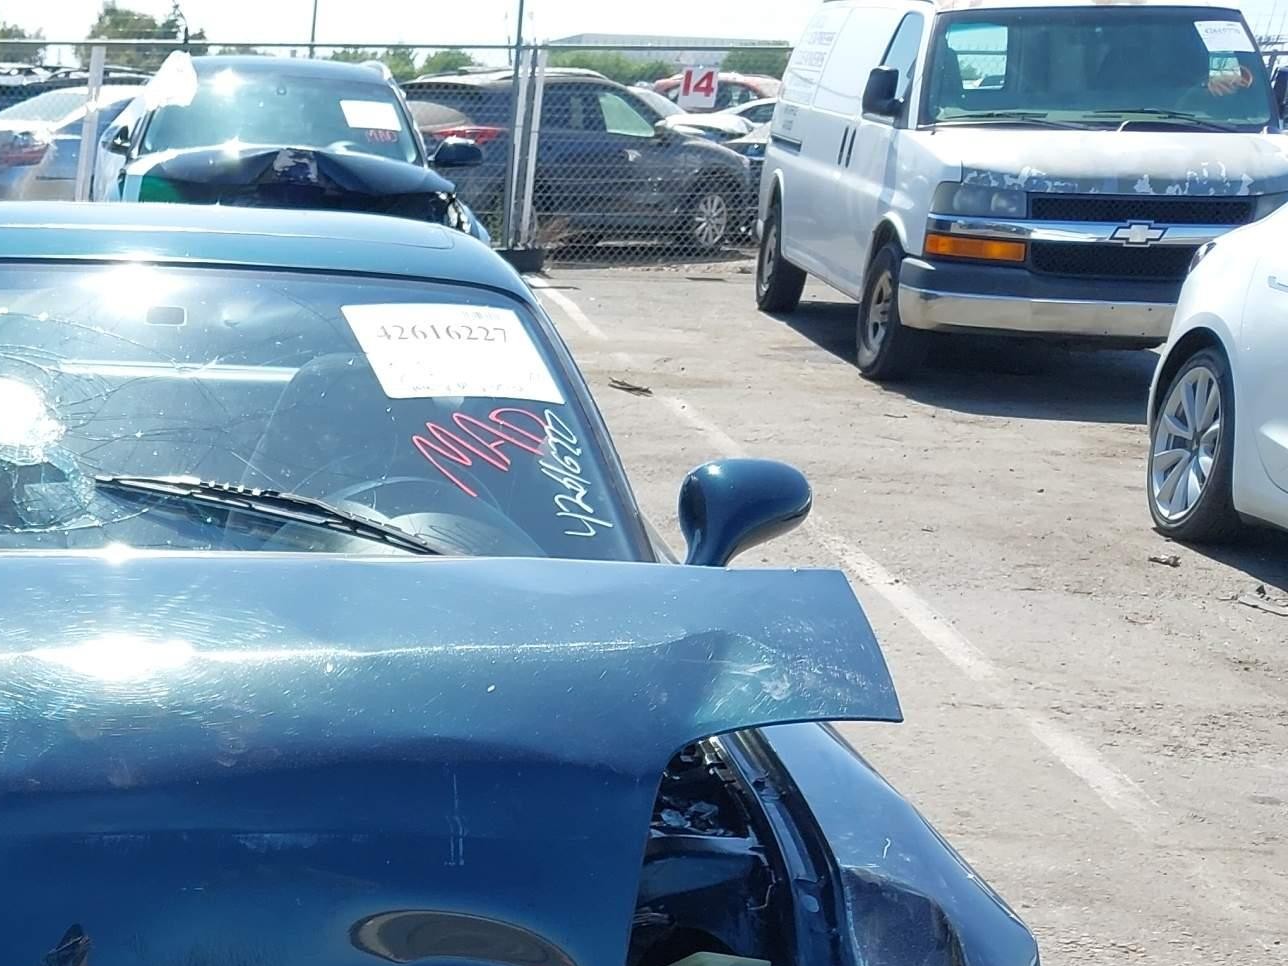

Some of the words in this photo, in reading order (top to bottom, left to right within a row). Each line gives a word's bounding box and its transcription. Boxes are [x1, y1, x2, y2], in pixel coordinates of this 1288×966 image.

[682, 69, 715, 97] 14
[376, 324, 507, 343] 42616227
[412, 408, 550, 497] MAD
